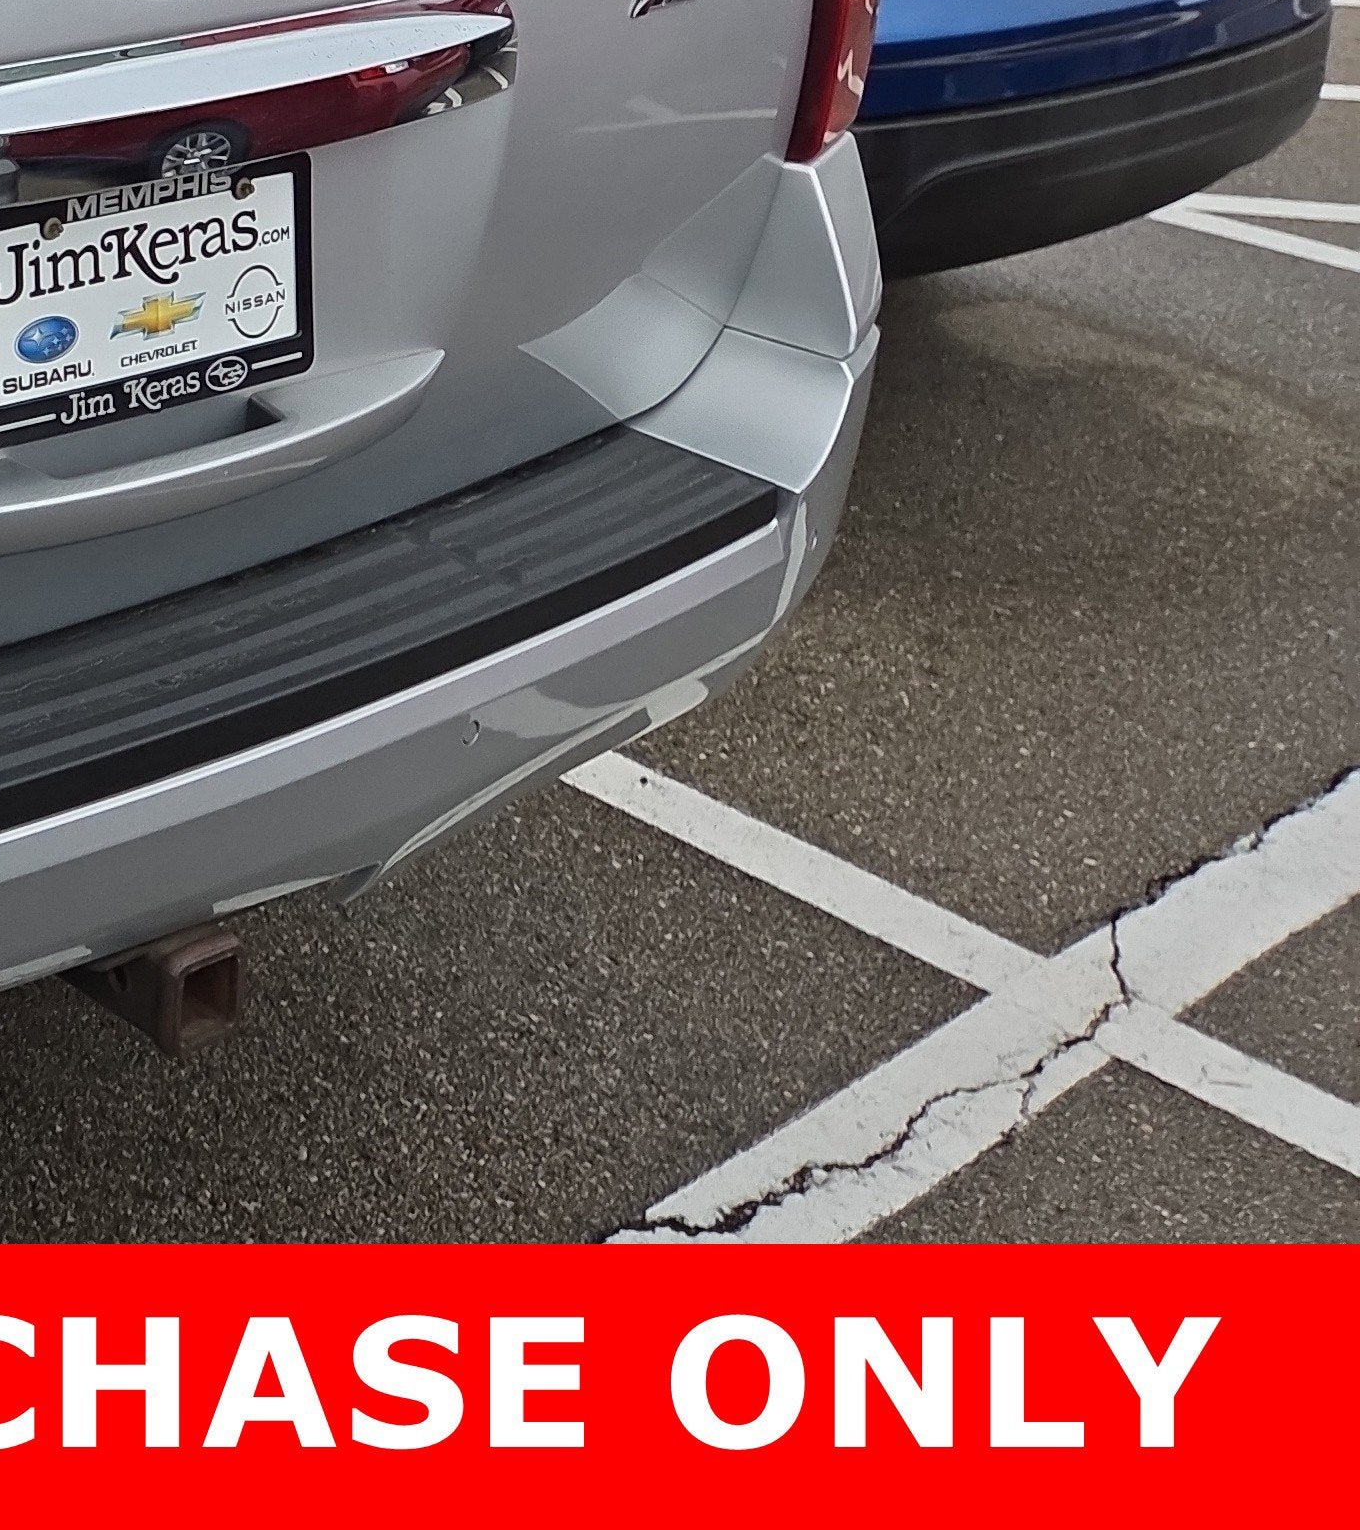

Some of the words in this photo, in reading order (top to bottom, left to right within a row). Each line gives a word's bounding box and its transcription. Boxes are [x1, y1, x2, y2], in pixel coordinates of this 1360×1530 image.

[66, 170, 232, 222] MEMPHIS
[225, 288, 286, 316] NISSAN
[120, 339, 200, 368] CHEVROLET
[2, 359, 93, 394] SUBARU
[60, 392, 117, 425] Jim
[123, 370, 201, 411] Keras
